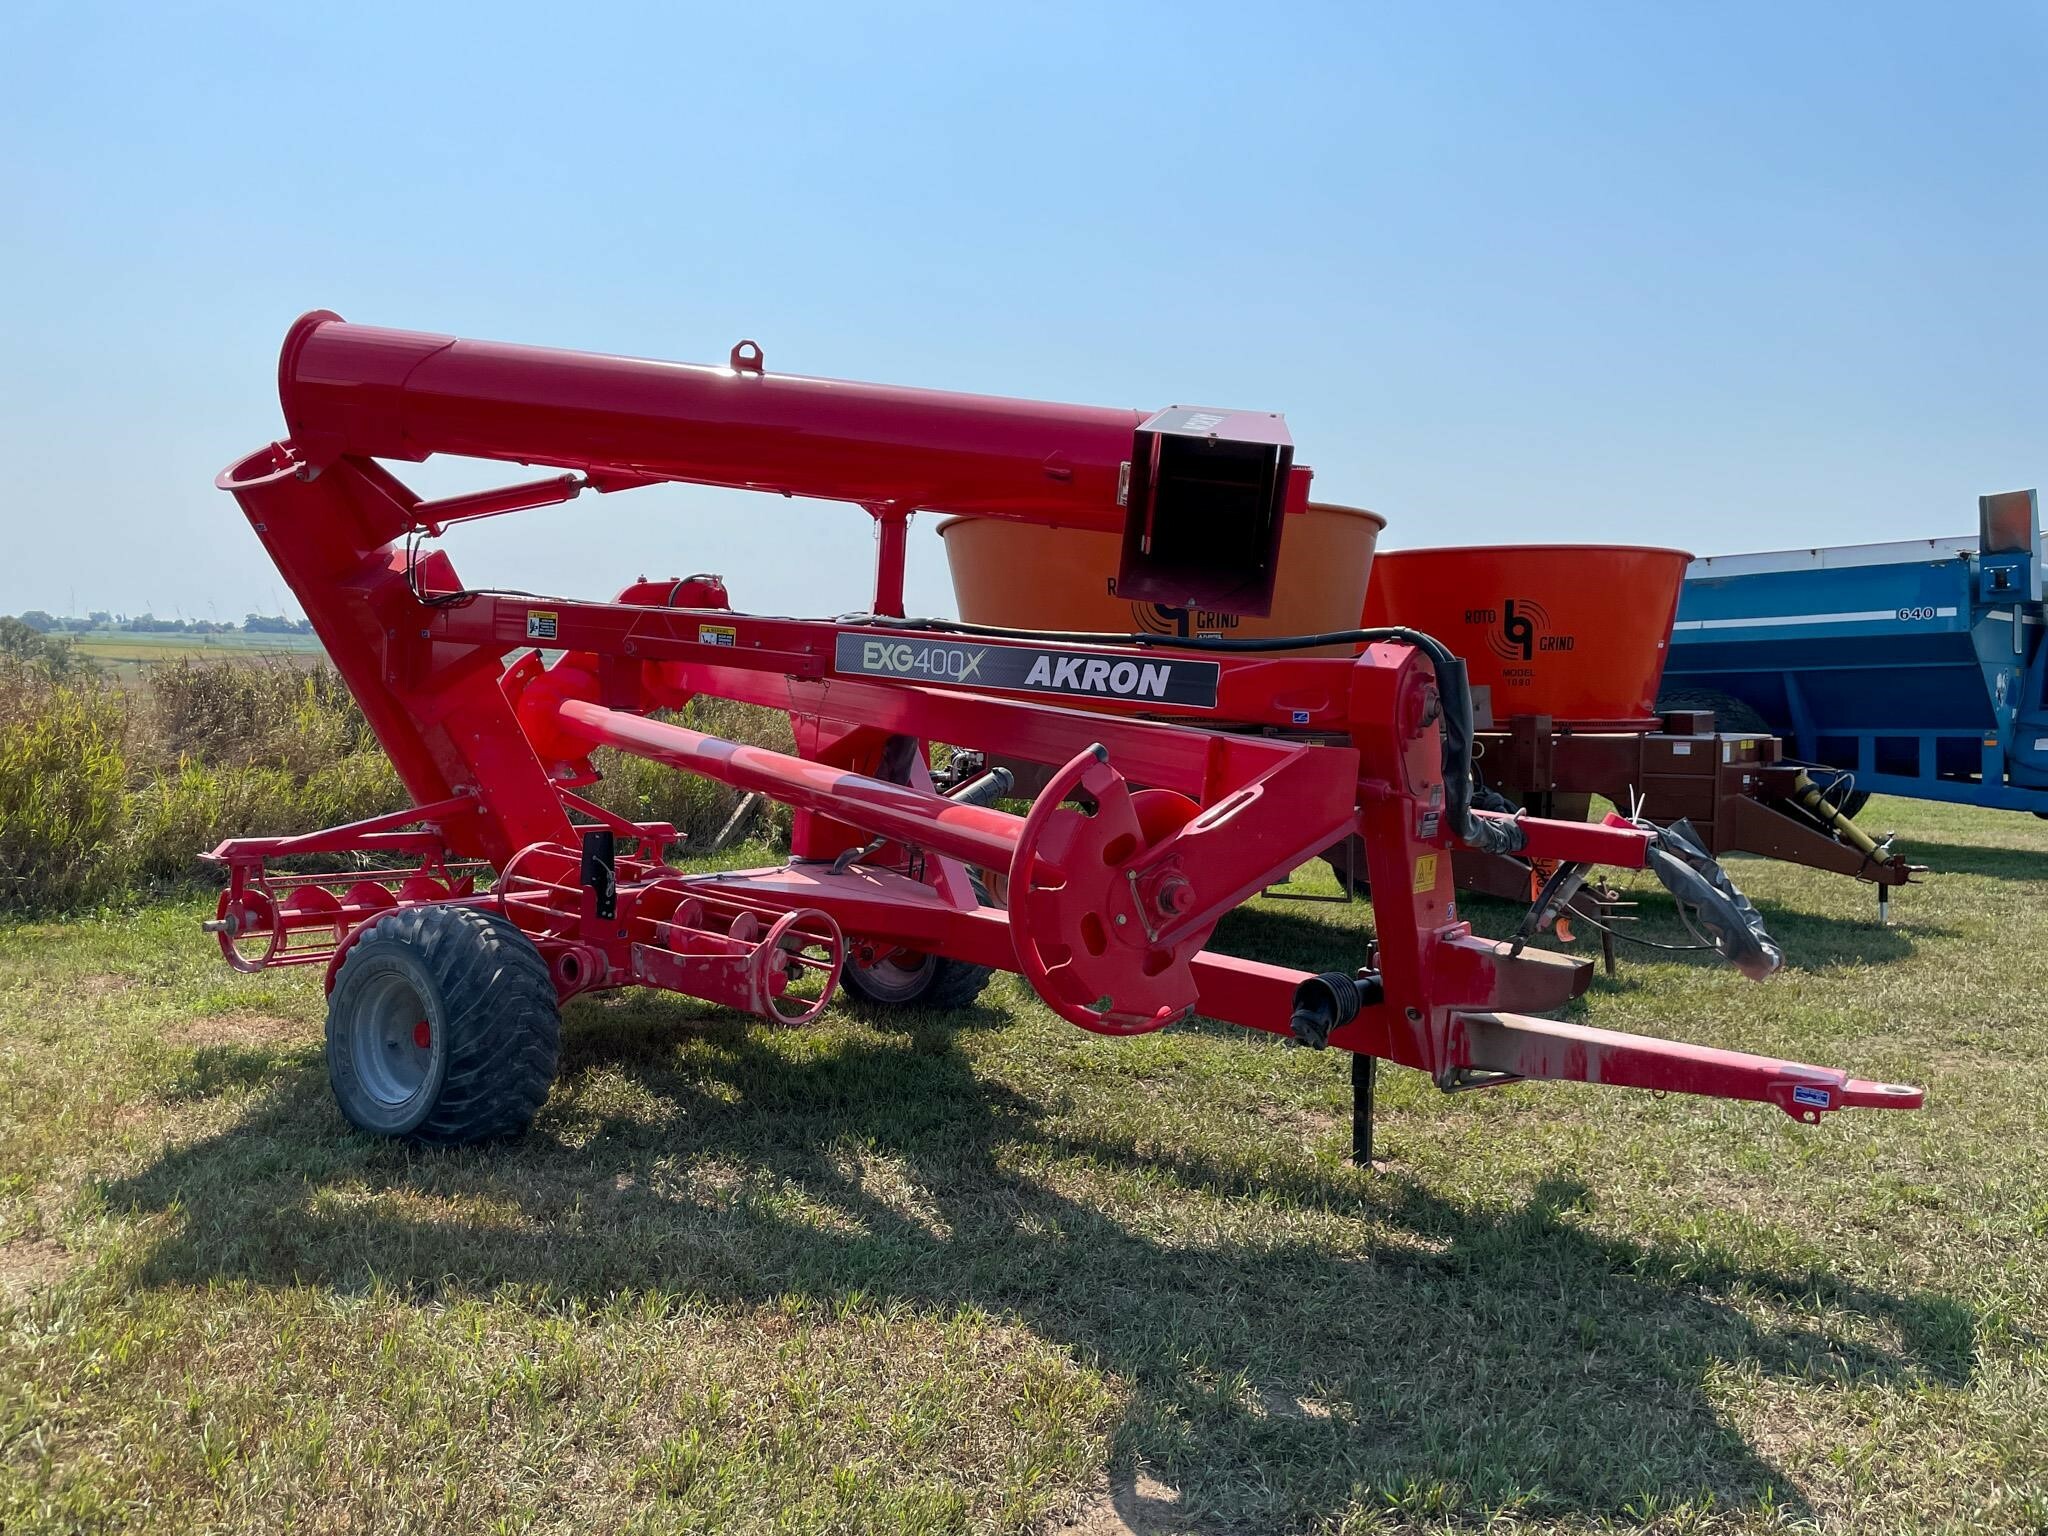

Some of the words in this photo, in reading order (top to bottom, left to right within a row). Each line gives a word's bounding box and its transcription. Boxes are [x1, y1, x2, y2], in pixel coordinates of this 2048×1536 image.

[1196, 610, 1239, 629] GRIND
[1465, 609, 1496, 624] ROTO
[1898, 606, 1935, 621] 640
[1540, 636, 1575, 651] GRIND
[863, 641, 987, 682] EXG400X
[1024, 655, 1172, 697] AKRON
[1503, 668, 1536, 678] MODEL
